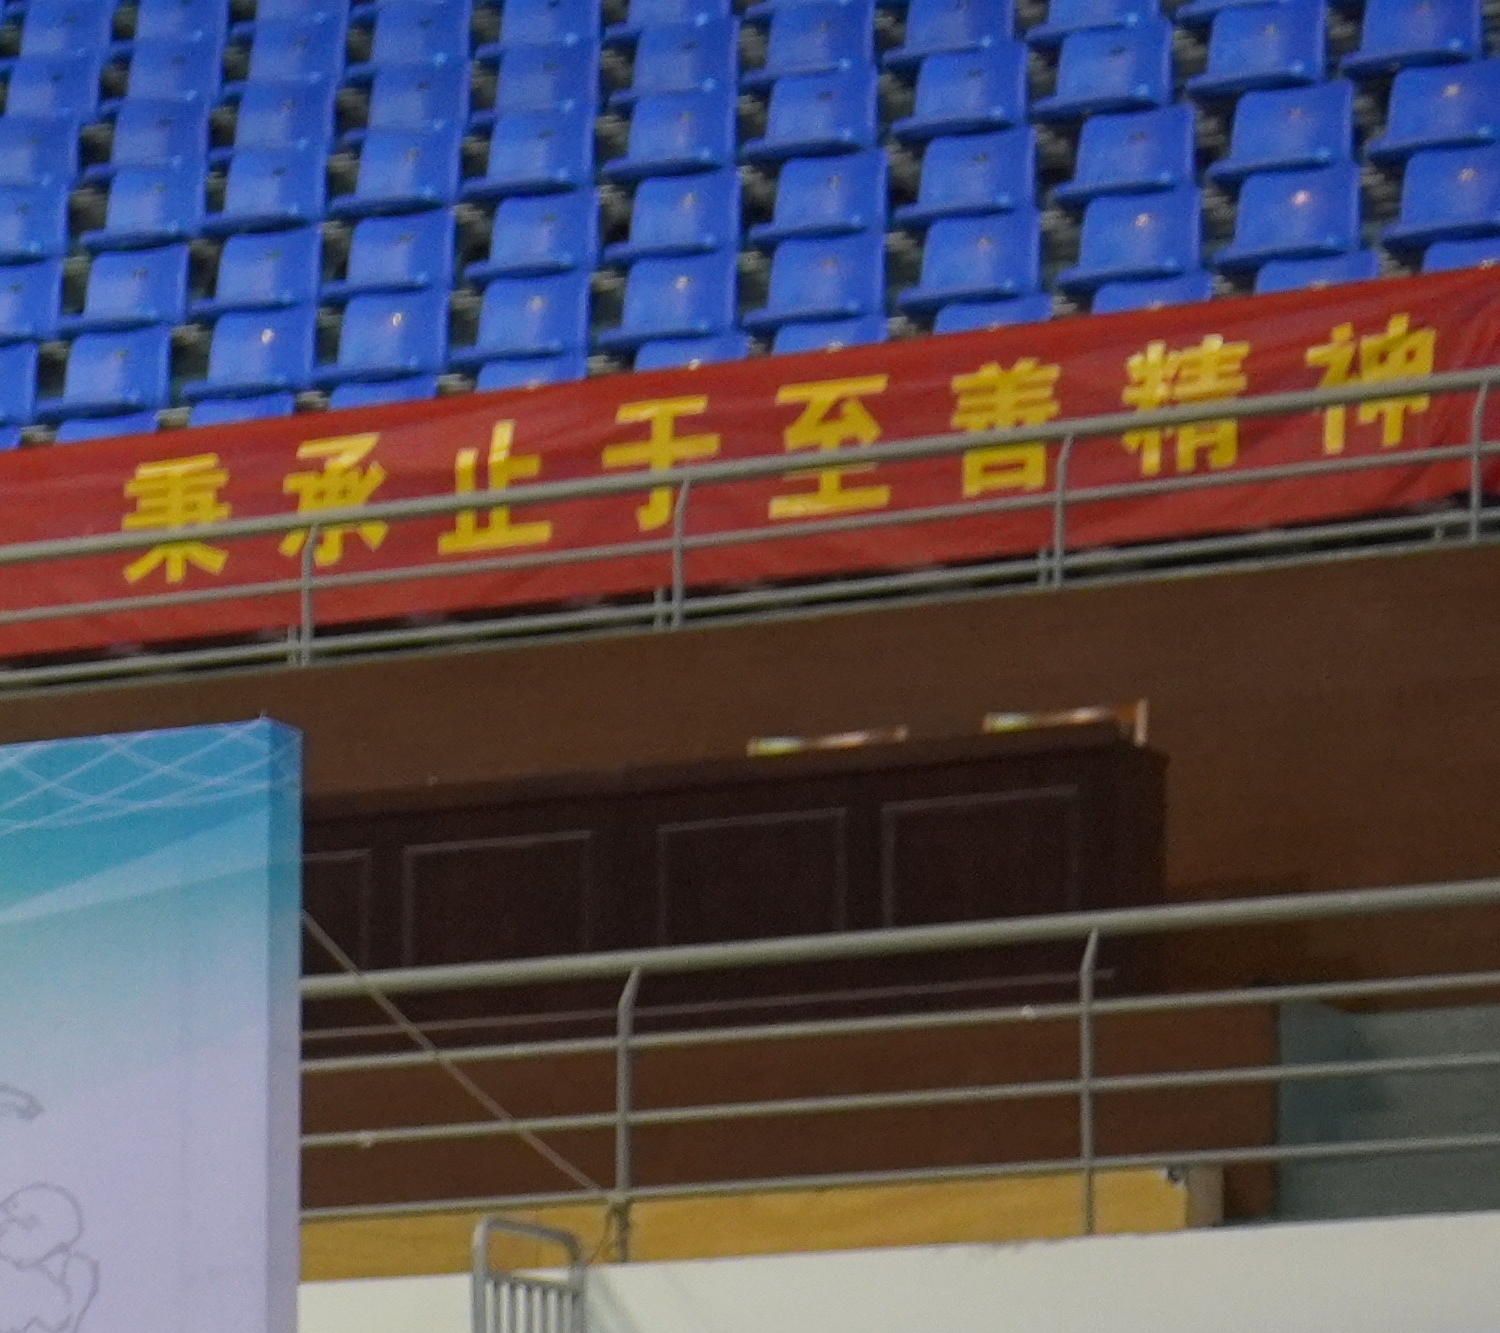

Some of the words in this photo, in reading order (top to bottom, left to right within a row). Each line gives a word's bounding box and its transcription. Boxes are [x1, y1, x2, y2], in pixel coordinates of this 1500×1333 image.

[121, 312, 1438, 585] 秉承止于至善精神
